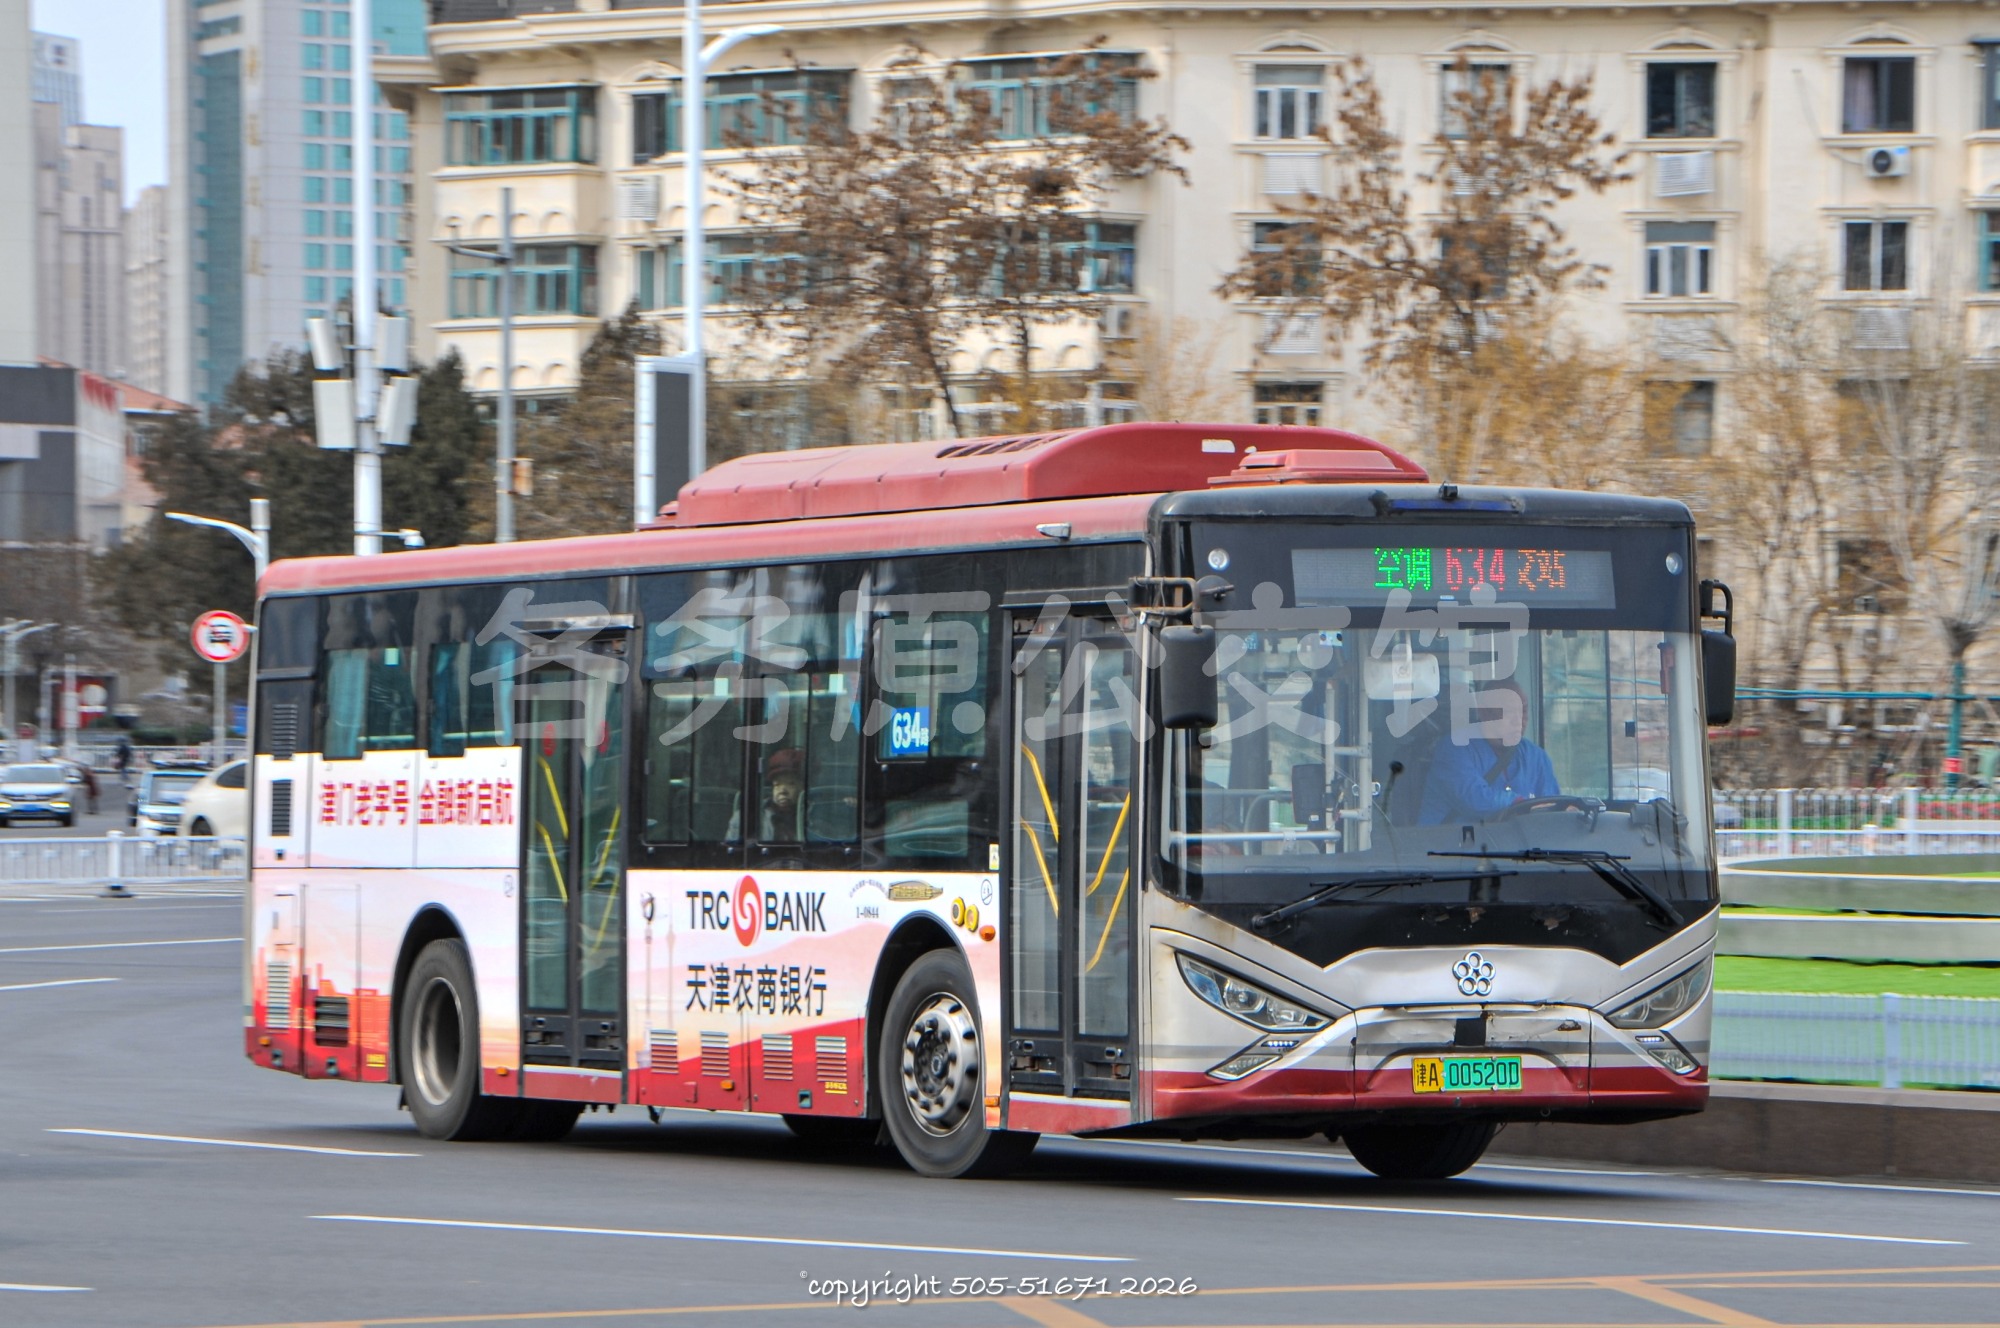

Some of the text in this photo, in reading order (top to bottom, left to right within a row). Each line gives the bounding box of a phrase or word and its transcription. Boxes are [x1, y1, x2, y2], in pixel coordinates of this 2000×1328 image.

[1374, 547, 1431, 590] 空调
[1446, 548, 1506, 591] 634
[320, 778, 514, 826] 津门老字号 金融新启航
[686, 890, 826, 932] TRC BANK
[686, 962, 827, 1017] 天津农商银行
